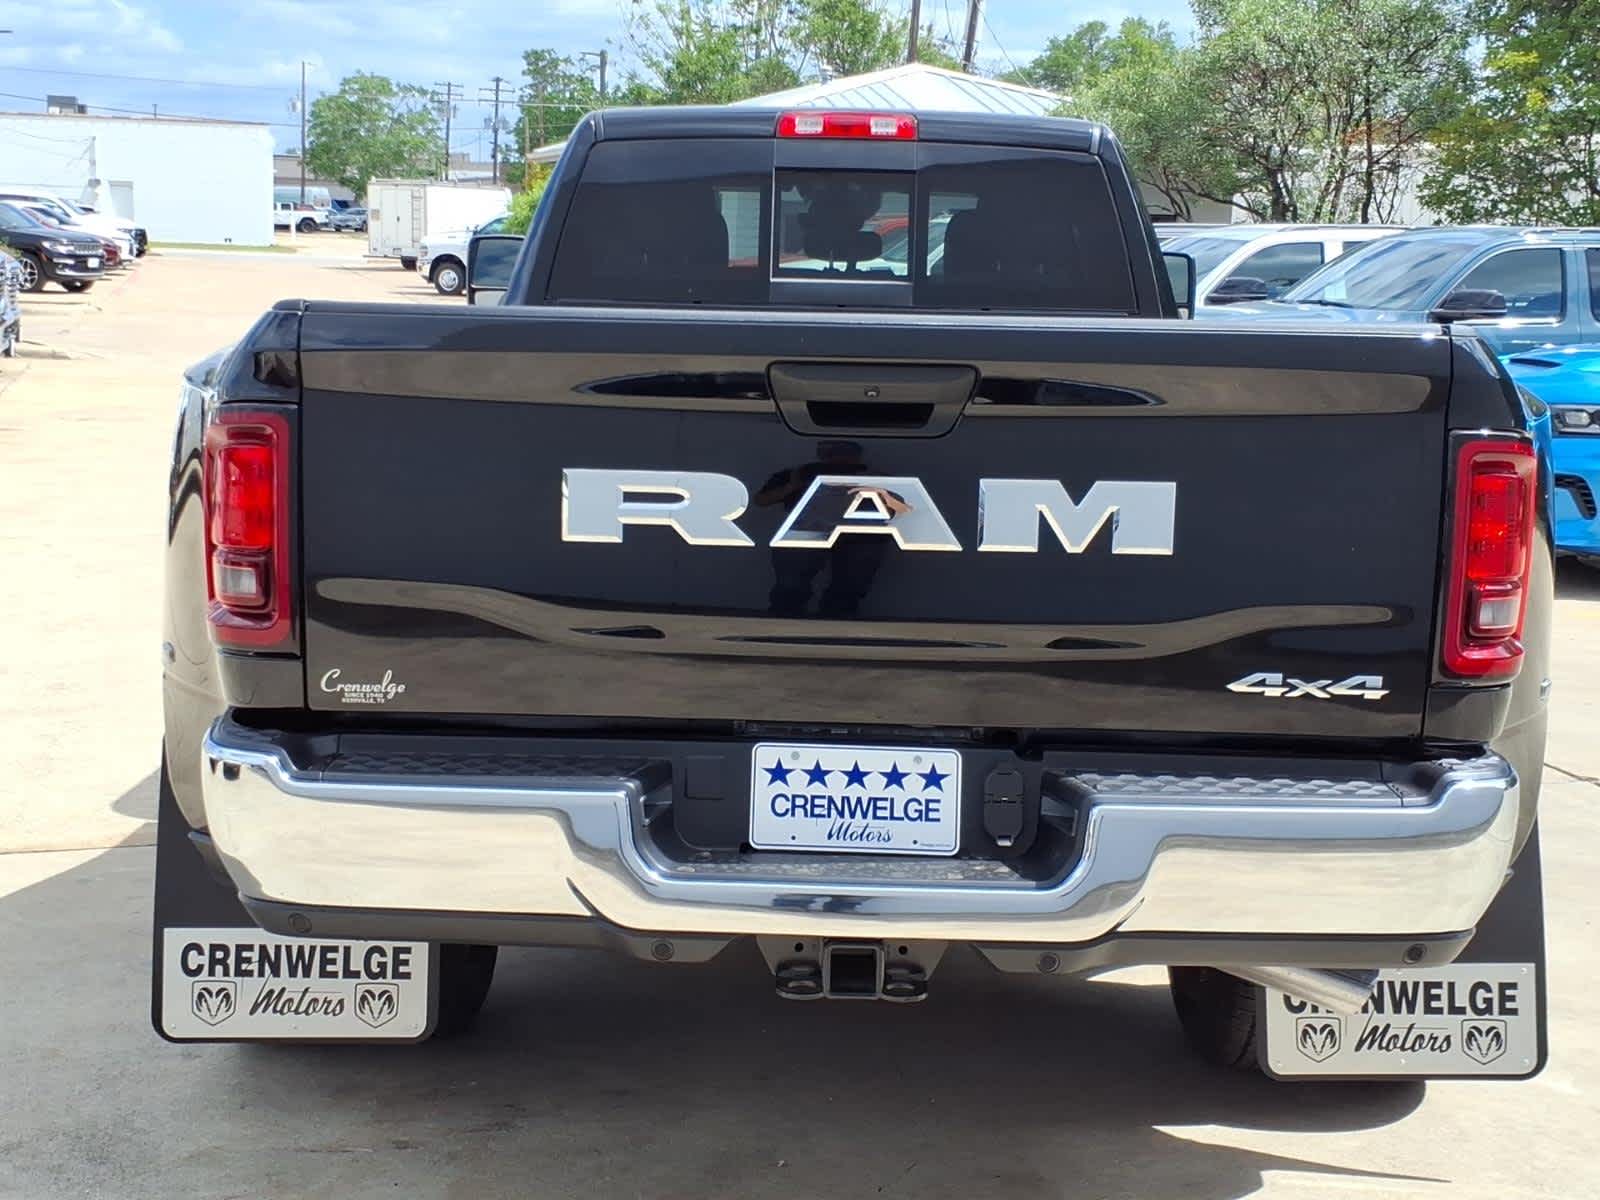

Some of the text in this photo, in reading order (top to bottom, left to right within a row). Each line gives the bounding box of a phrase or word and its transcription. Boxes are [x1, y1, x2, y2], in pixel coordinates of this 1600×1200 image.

[562, 468, 1177, 556] RAM
[320, 668, 406, 699] Crenwelge
[1226, 672, 1390, 700] 4x4
[770, 793, 941, 822] CRENWELGE
[826, 817, 893, 843] Motors
[180, 942, 412, 980] CRENWELGE
[249, 980, 345, 1017] Motors
[1283, 981, 1519, 1016] CNWELGE
[1354, 1017, 1452, 1053] Motors
